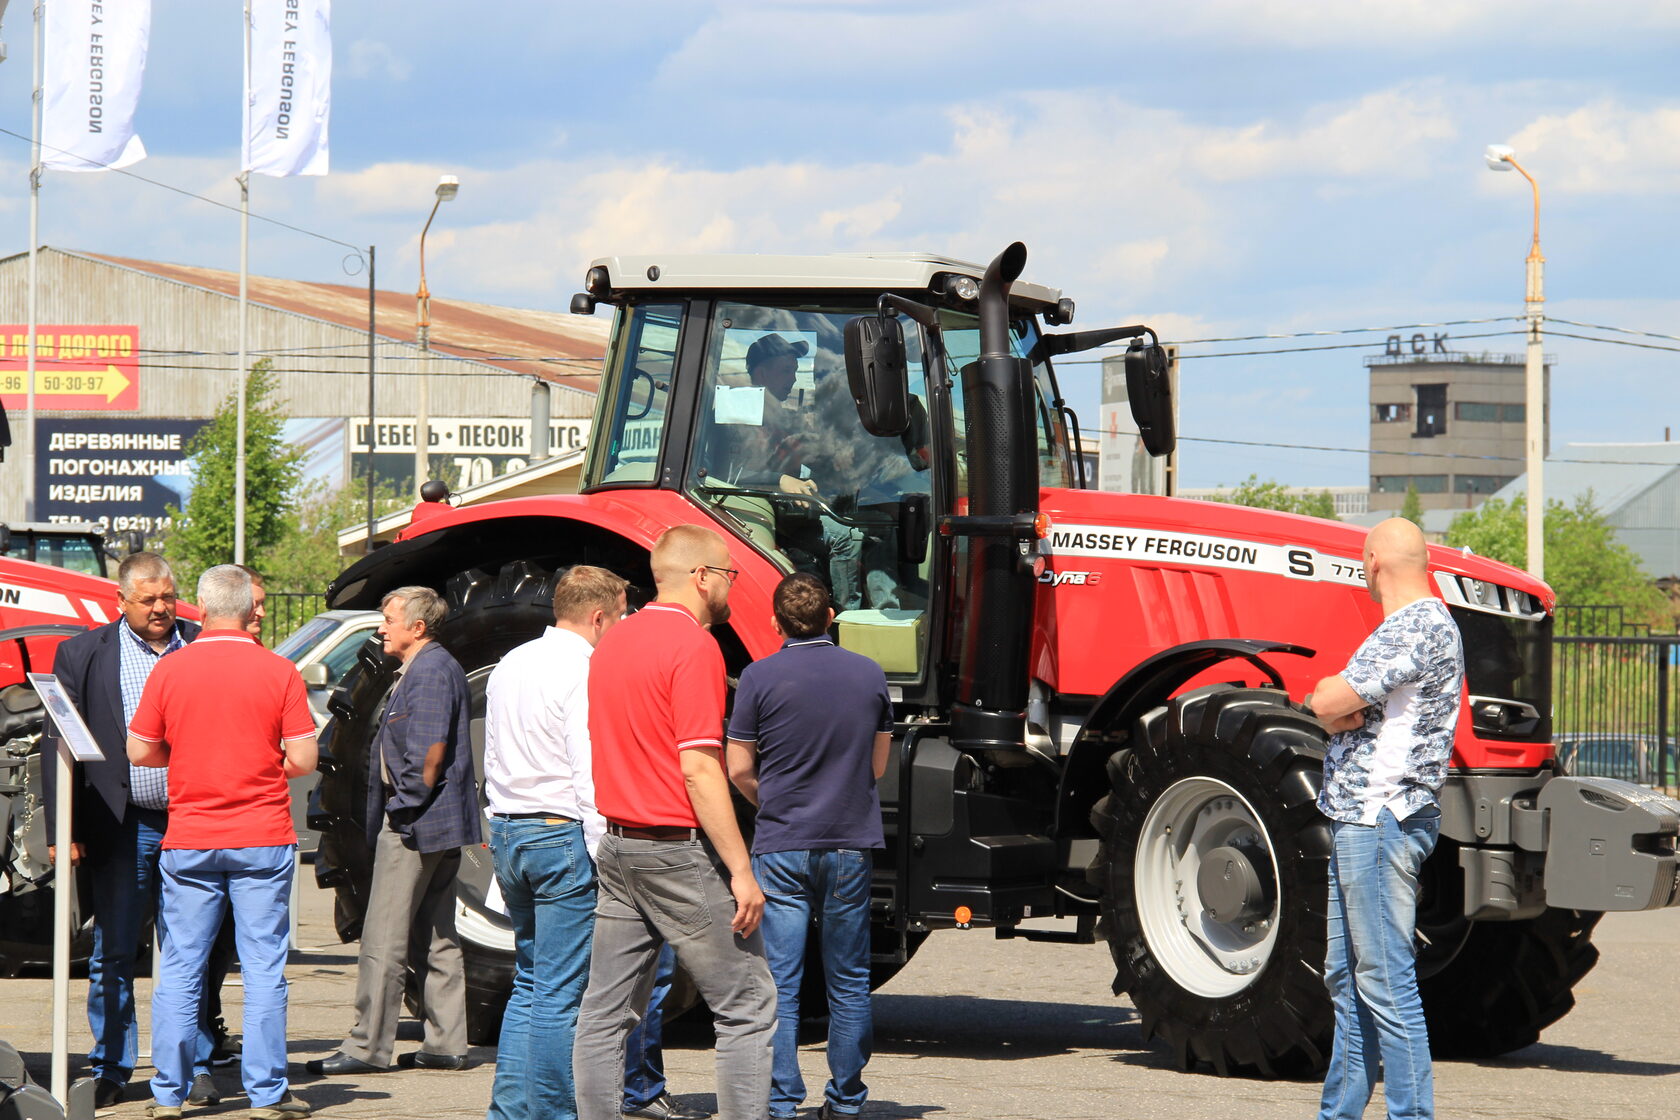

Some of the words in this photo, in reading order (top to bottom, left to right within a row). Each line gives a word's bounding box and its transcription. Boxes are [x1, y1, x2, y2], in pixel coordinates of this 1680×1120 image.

[58, 334, 132, 360] ДОРОГО
[1386, 332, 1448, 355] ДСК
[44, 376, 104, 390] 50-30-97
[49, 432, 182, 450] ДЕРЕВЯННЫЕ
[356, 424, 439, 449] ЩЕБЕЬ
[459, 425, 524, 447] ПЕСОК
[49, 458, 192, 476] ПОГОНАЖНЫЕ
[49, 484, 144, 503] ИЗДЕЛИЯ
[1052, 532, 1138, 553] MASSEY
[1144, 537, 1257, 565] FERGUSON
[1288, 550, 1315, 577] S
